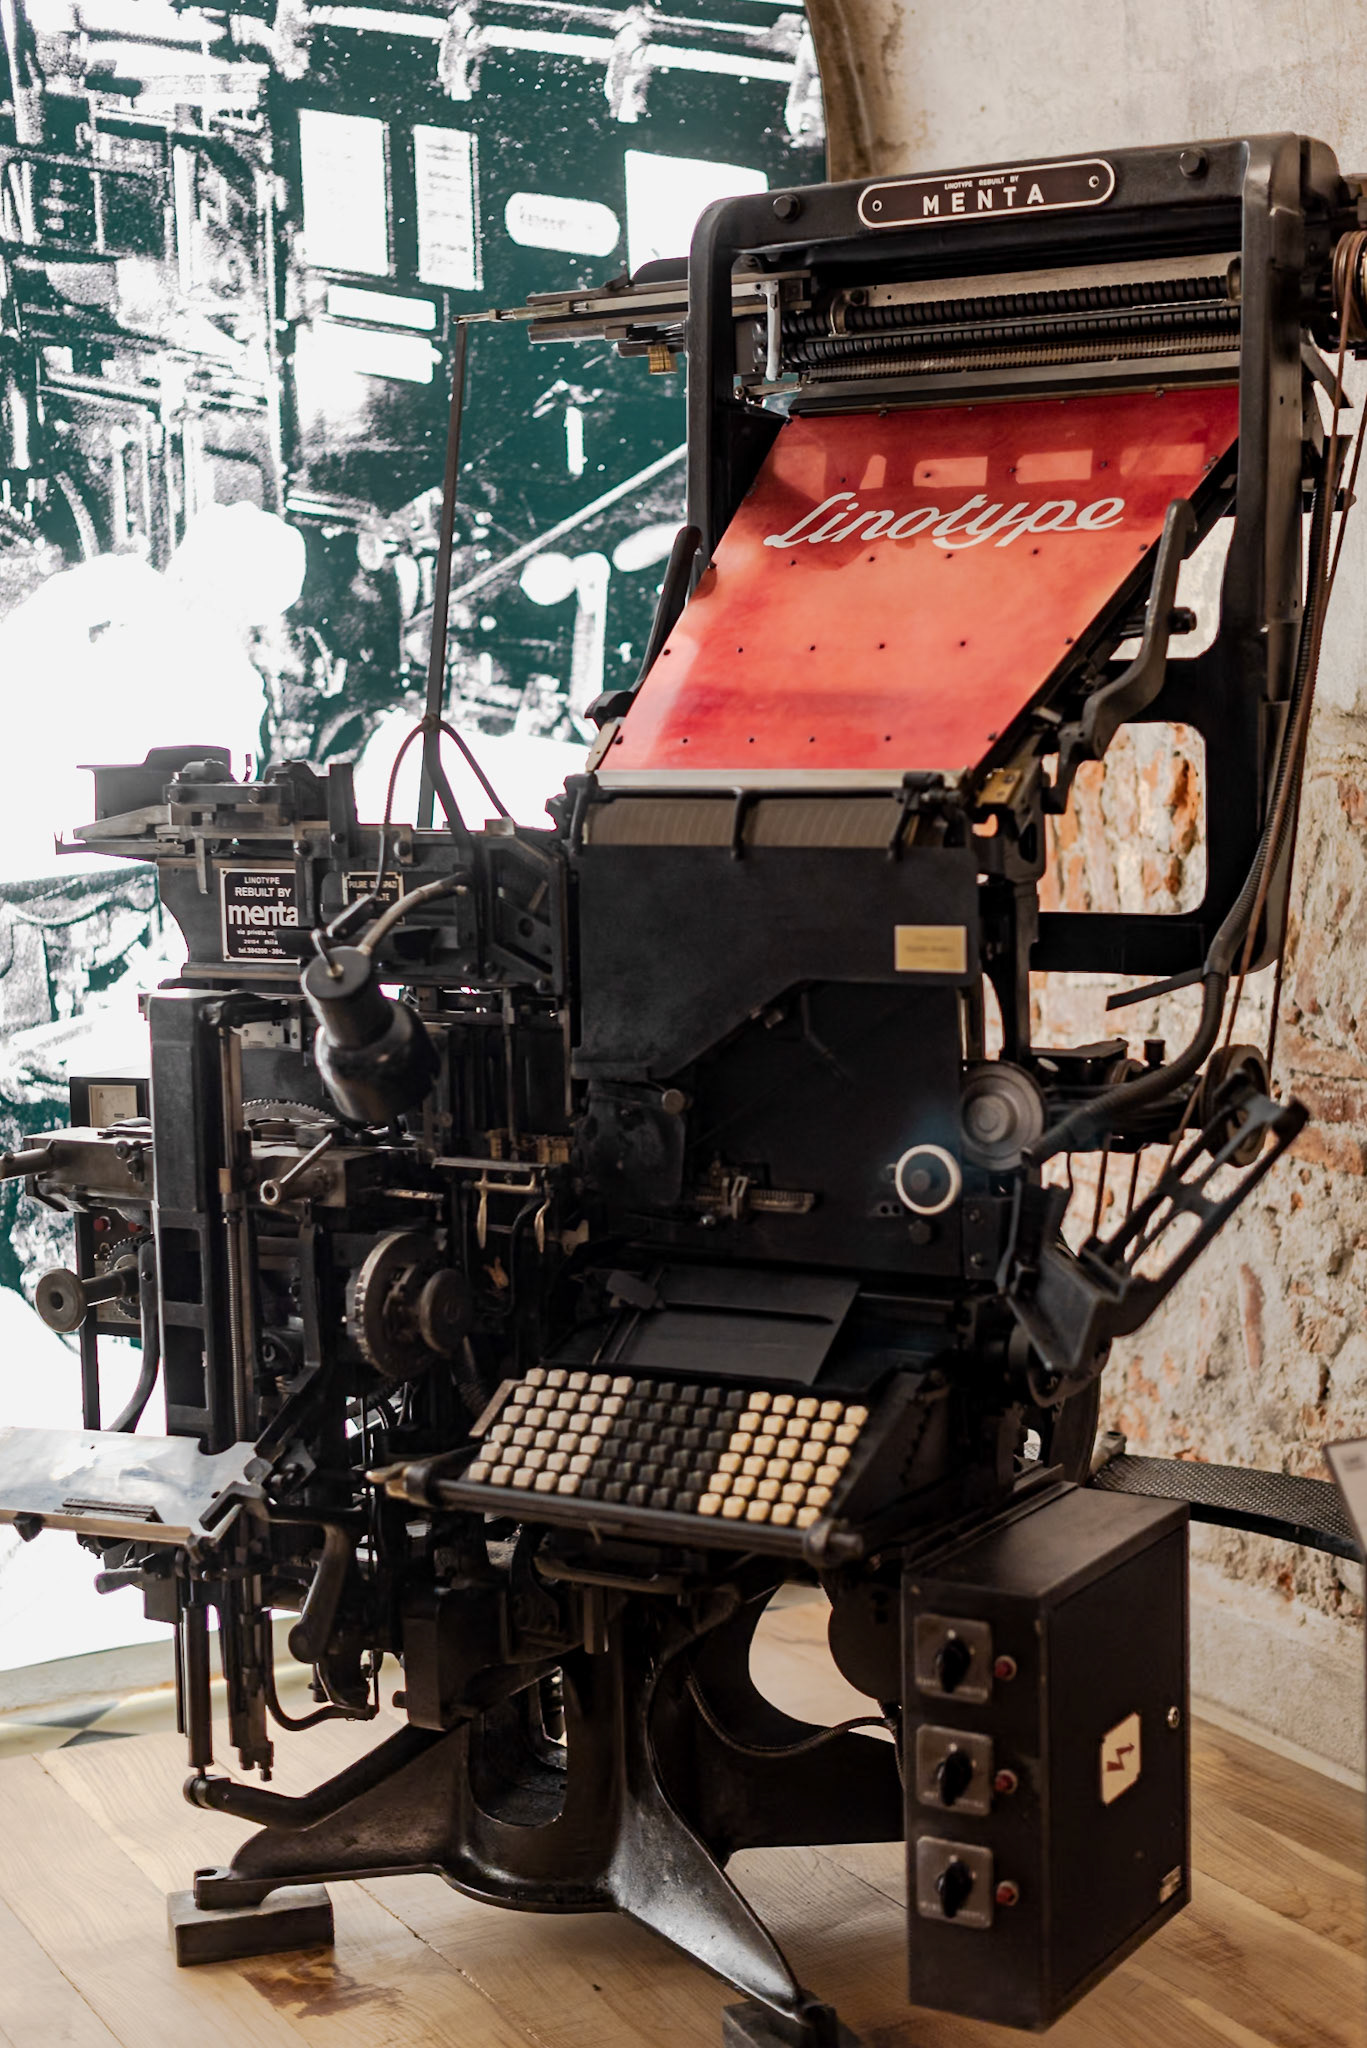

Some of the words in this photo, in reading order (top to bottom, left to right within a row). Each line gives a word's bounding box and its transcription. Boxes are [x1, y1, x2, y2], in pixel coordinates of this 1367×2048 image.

[944, 180, 973, 190] LINOTYPE
[978, 176, 1005, 186] REBUILT
[1009, 175, 1019, 183] BY
[923, 183, 1044, 216] MENTA
[763, 491, 1125, 550] Linotype
[244, 876, 280, 885] LINOTYPE
[234, 887, 275, 897] REBUILT
[277, 888, 291, 898] BY
[227, 901, 299, 926] menta
